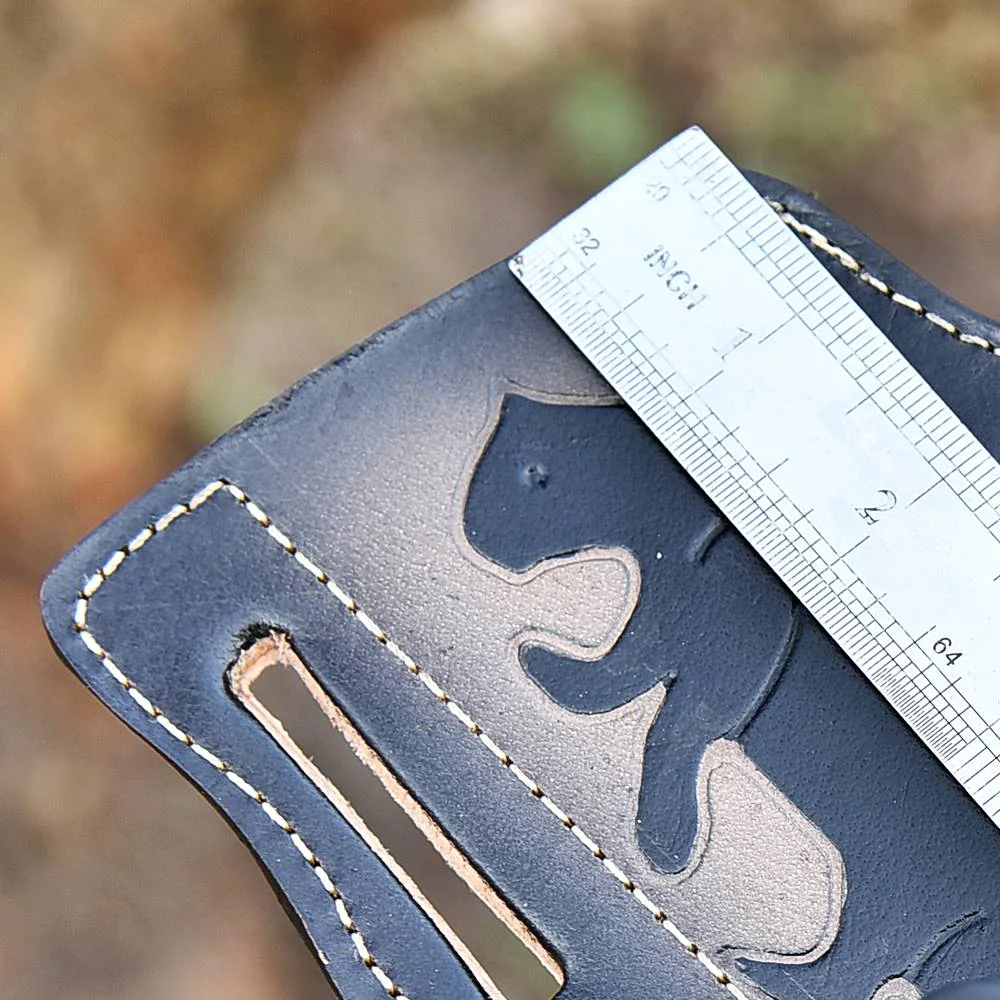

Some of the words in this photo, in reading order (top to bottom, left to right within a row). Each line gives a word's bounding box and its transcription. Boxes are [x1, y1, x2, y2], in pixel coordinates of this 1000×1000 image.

[572, 227, 601, 256] 32
[643, 245, 707, 311] INCH
[712, 327, 753, 361] 1
[855, 489, 897, 525] 2
[932, 637, 963, 666] 64
